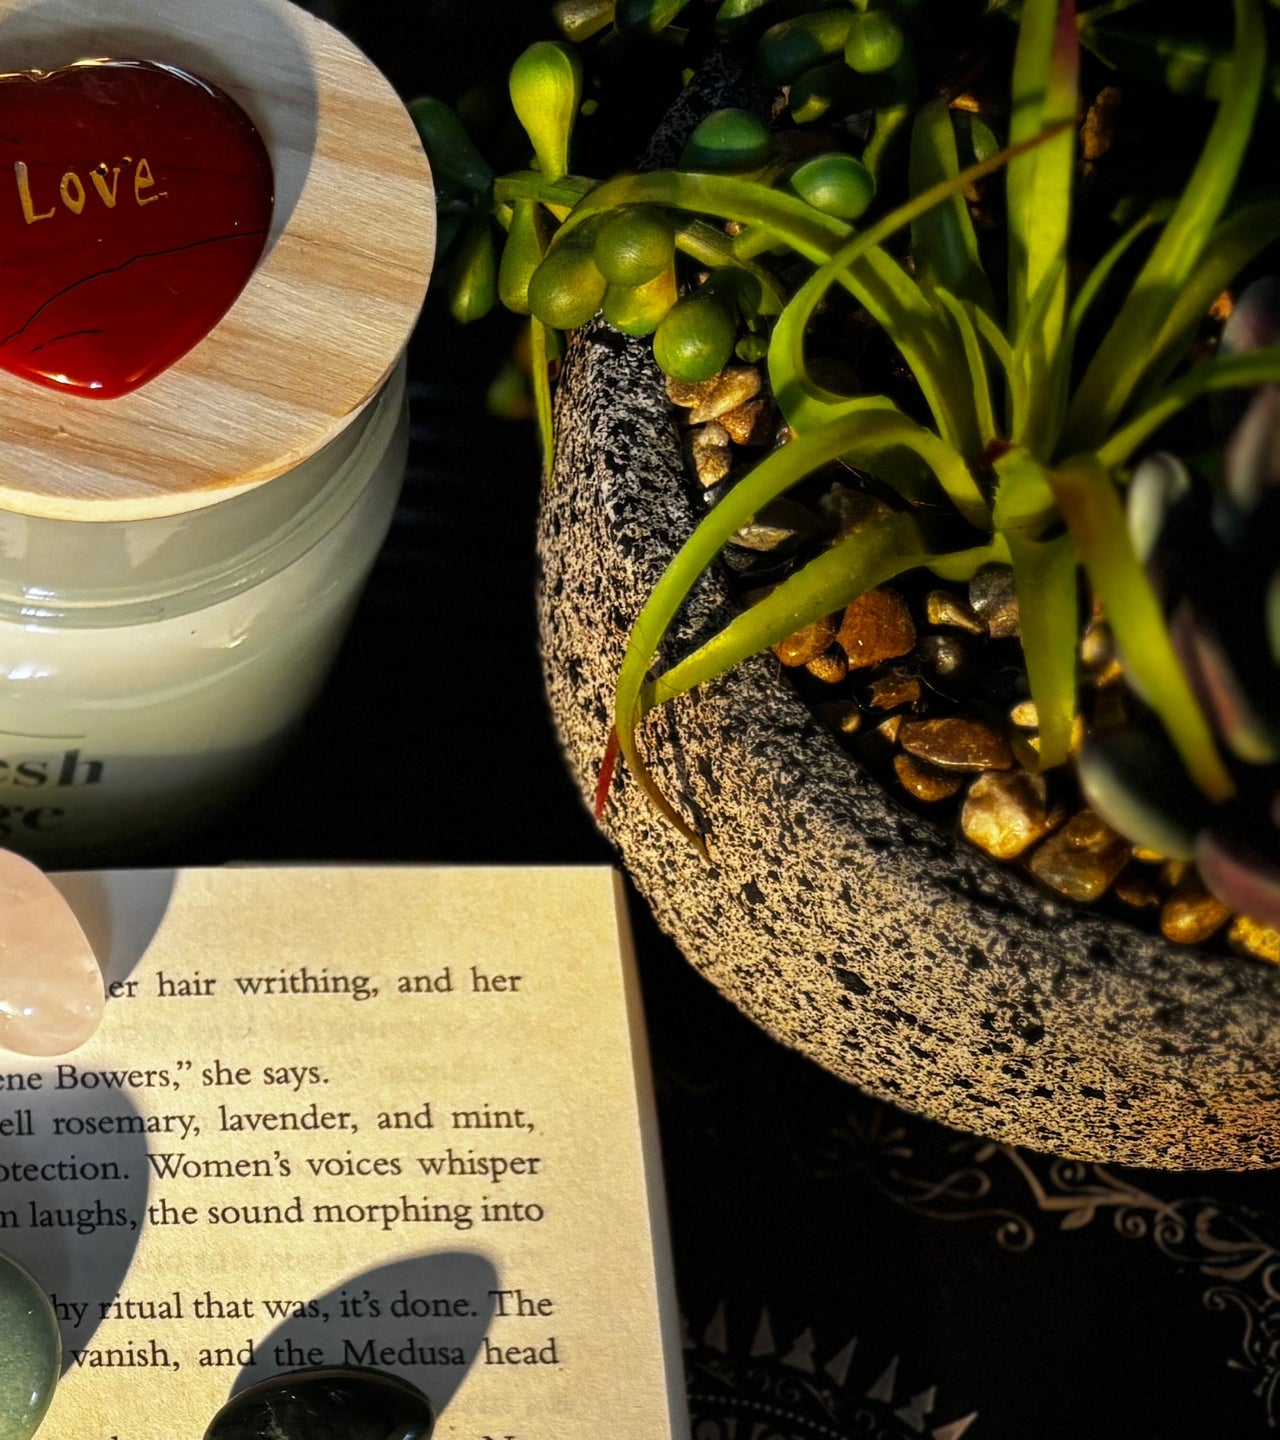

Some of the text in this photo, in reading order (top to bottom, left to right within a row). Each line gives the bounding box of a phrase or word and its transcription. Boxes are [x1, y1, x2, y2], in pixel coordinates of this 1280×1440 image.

[14, 159, 168, 225] Love
[54, 1059, 193, 1091] Bowers,”
[201, 1058, 252, 1087] she
[262, 1065, 330, 1093] says.
[144, 1149, 292, 1180] Women’s
[305, 1157, 403, 1177] voices
[416, 1147, 542, 1185] whisper
[97, 1288, 554, 1324] ritual that was, it’s done. The
